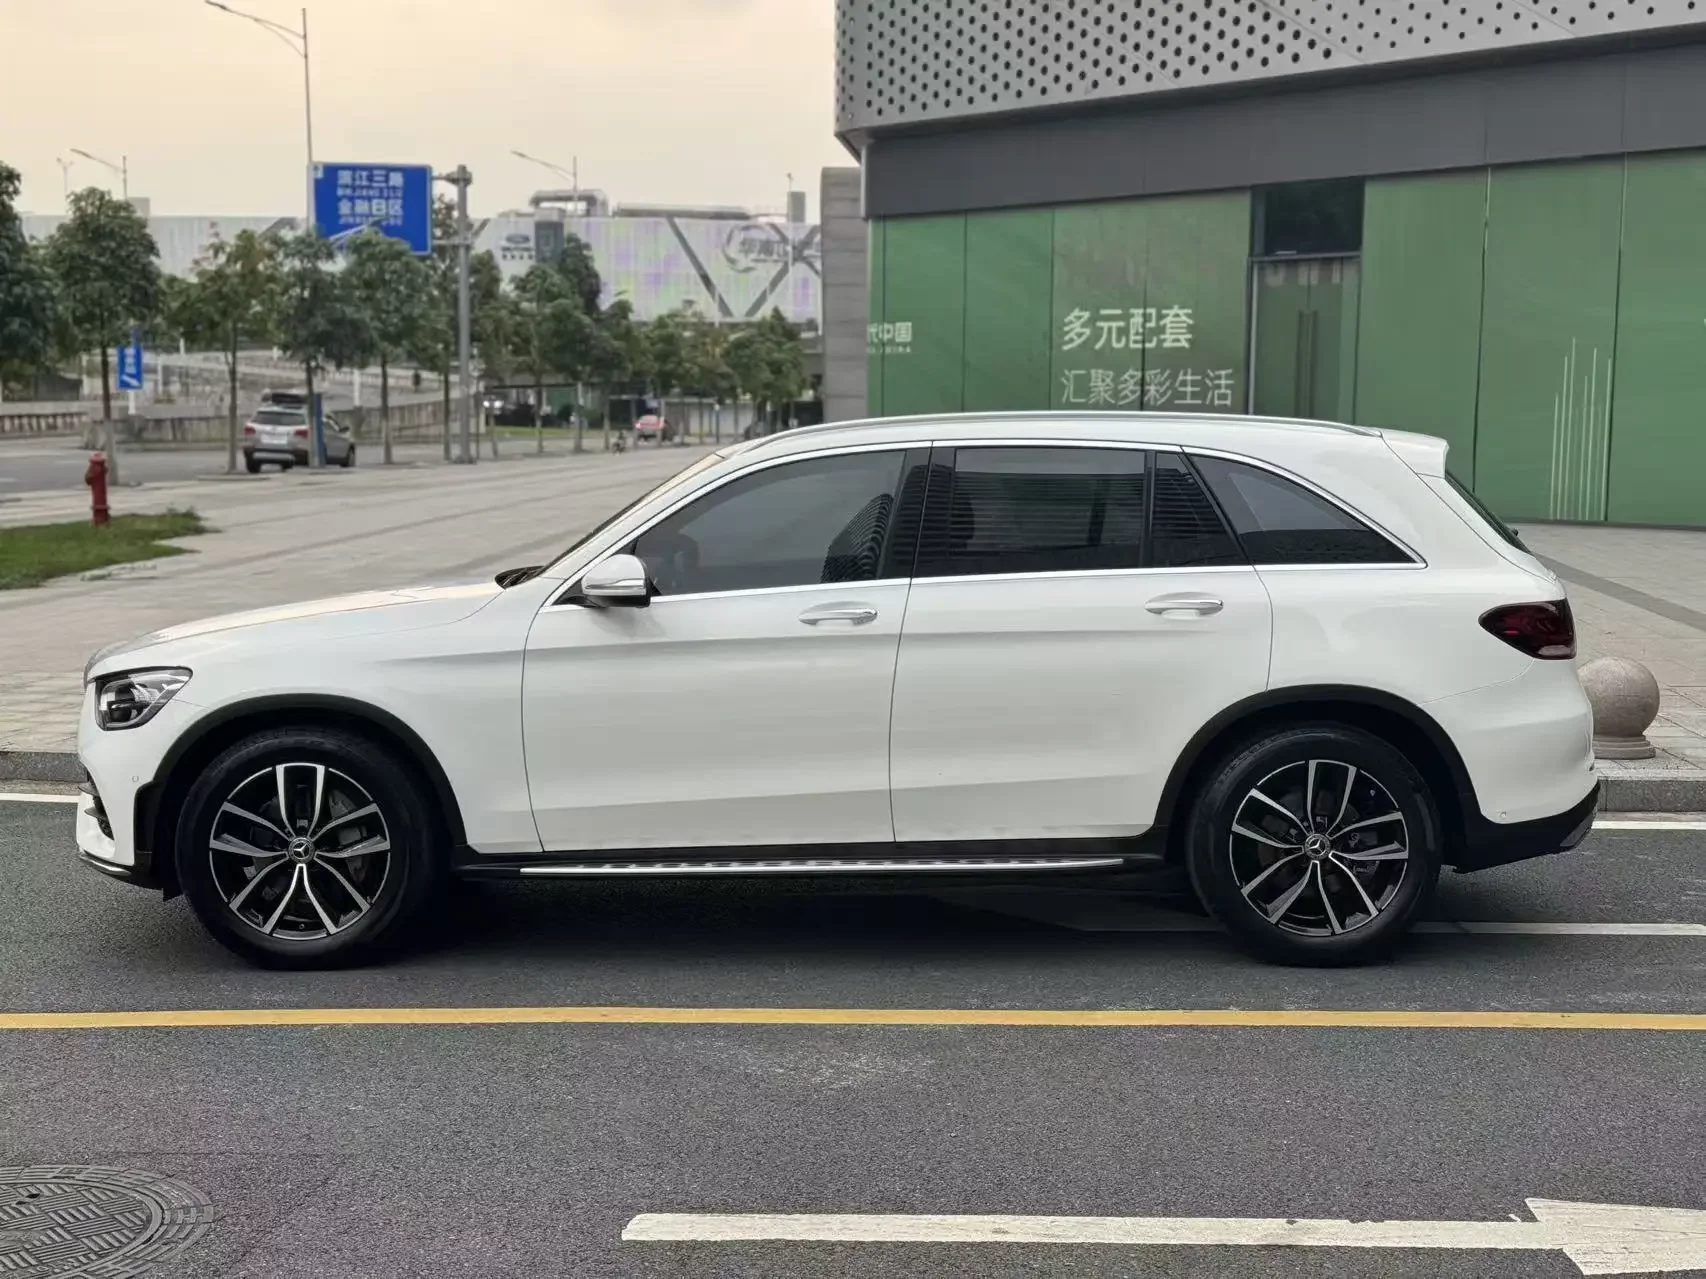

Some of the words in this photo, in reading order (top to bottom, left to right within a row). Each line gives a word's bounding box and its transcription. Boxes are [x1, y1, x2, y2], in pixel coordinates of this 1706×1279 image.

[1062, 305, 1194, 350] 多元配套
[1061, 368, 1235, 407] 汇聚多彩生活
